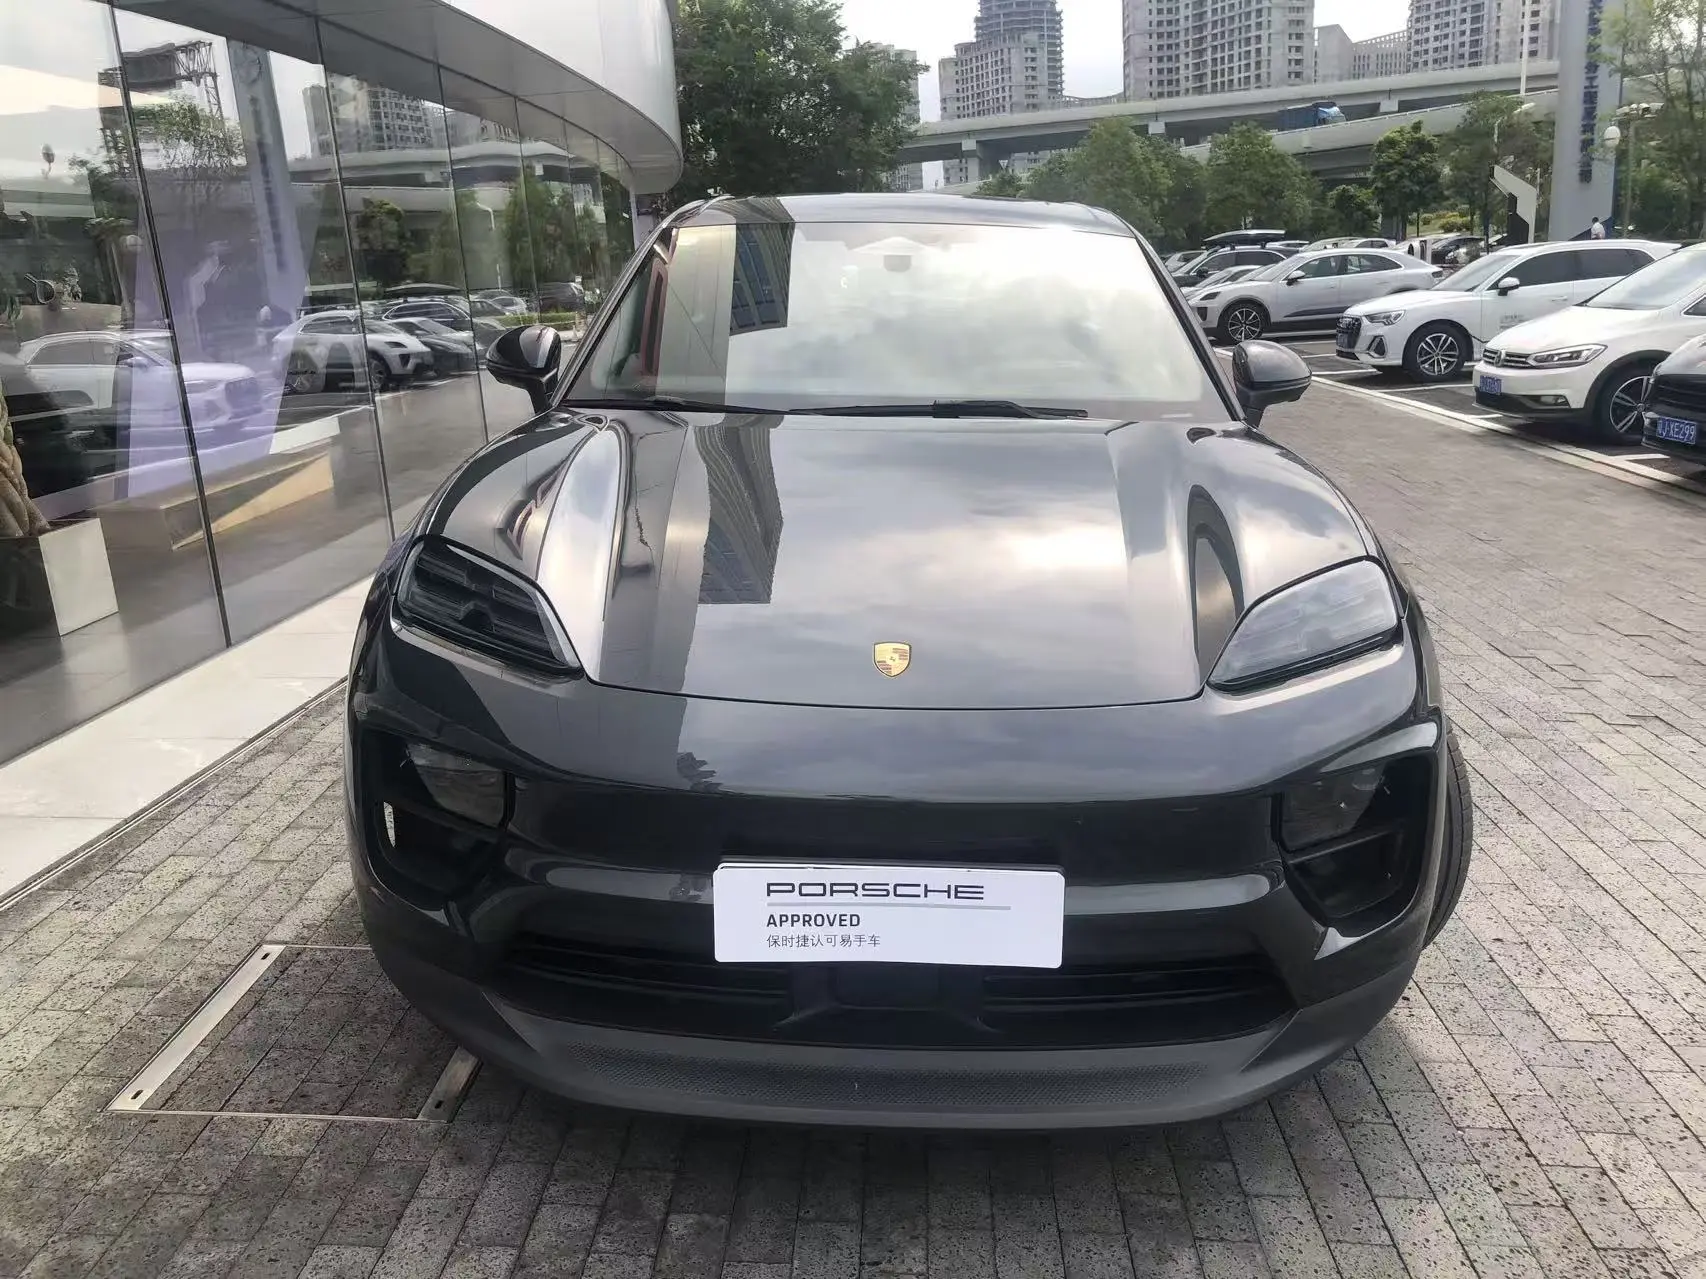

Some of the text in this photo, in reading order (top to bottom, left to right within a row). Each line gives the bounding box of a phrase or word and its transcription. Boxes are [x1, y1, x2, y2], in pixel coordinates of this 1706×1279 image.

[766, 882, 984, 900] PORSCHE
[766, 913, 861, 928] APPROVED
[766, 934, 881, 948] 保时捷认可易手车
